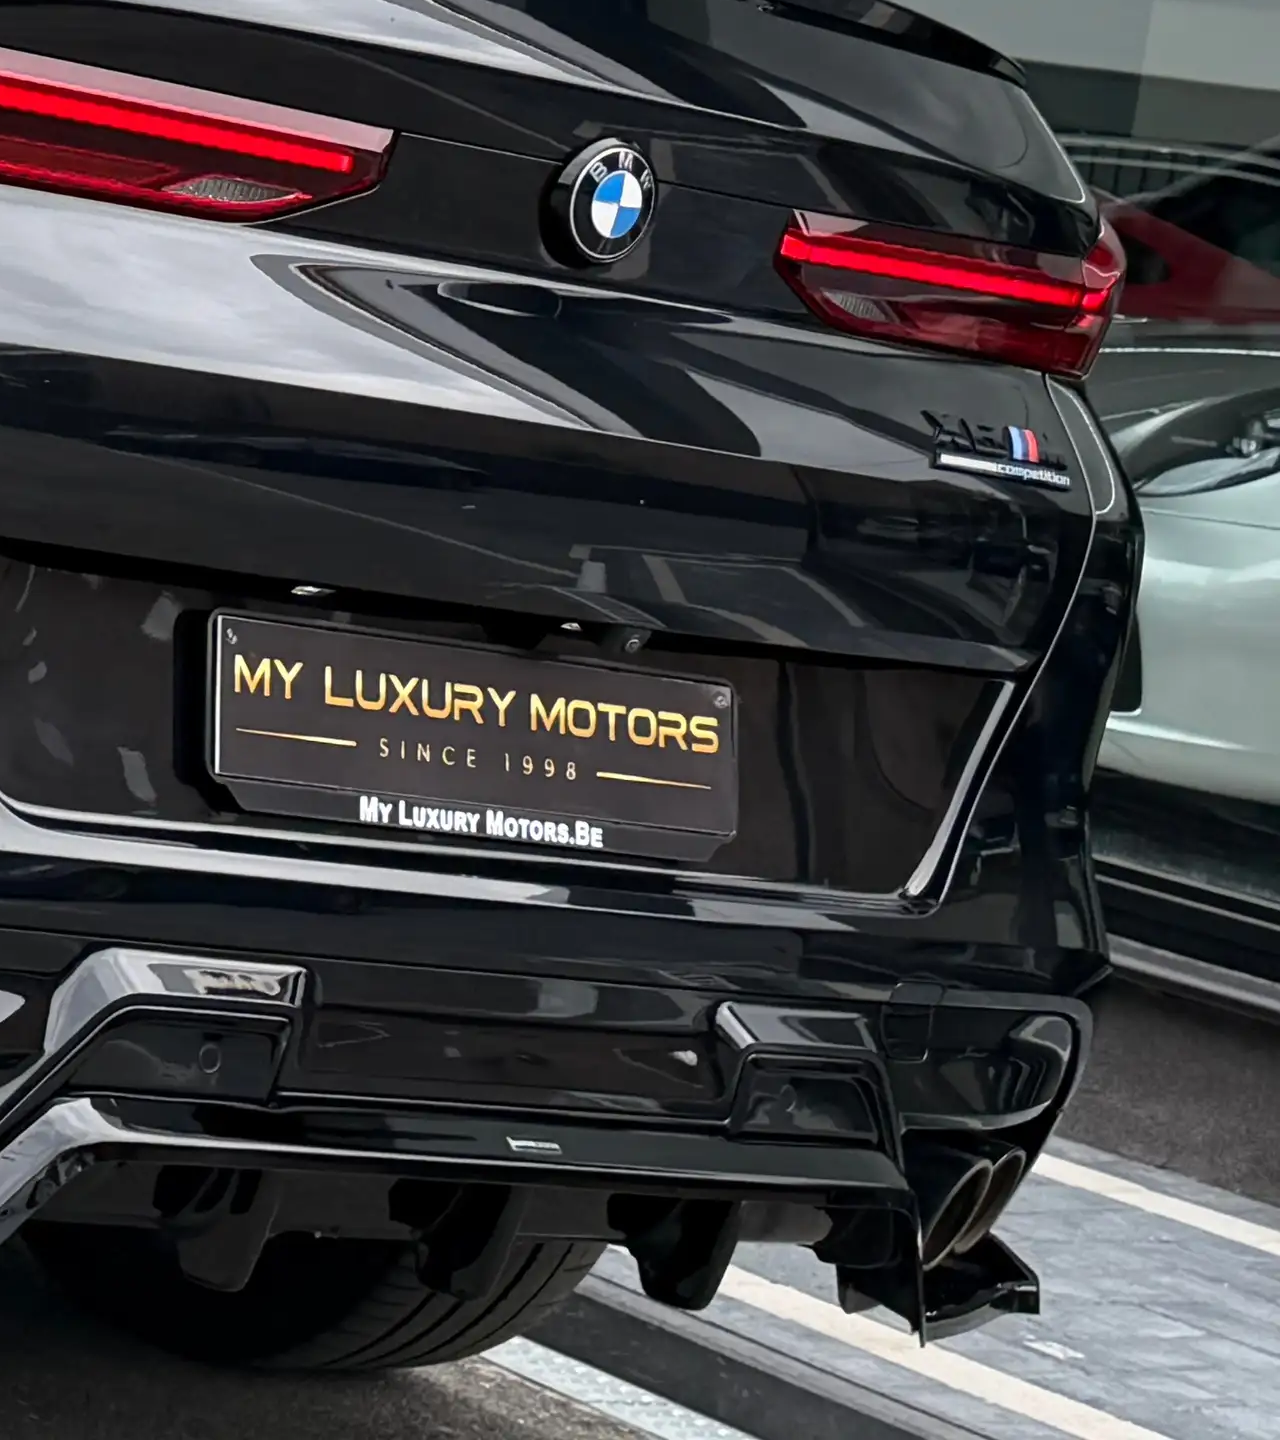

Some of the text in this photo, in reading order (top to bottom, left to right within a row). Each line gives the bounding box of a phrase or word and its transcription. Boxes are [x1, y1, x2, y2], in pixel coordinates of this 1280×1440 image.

[589, 150, 653, 190] BMW
[233, 654, 720, 754] MY LUXURY MOTORS
[379, 738, 577, 780] SINCE 1998
